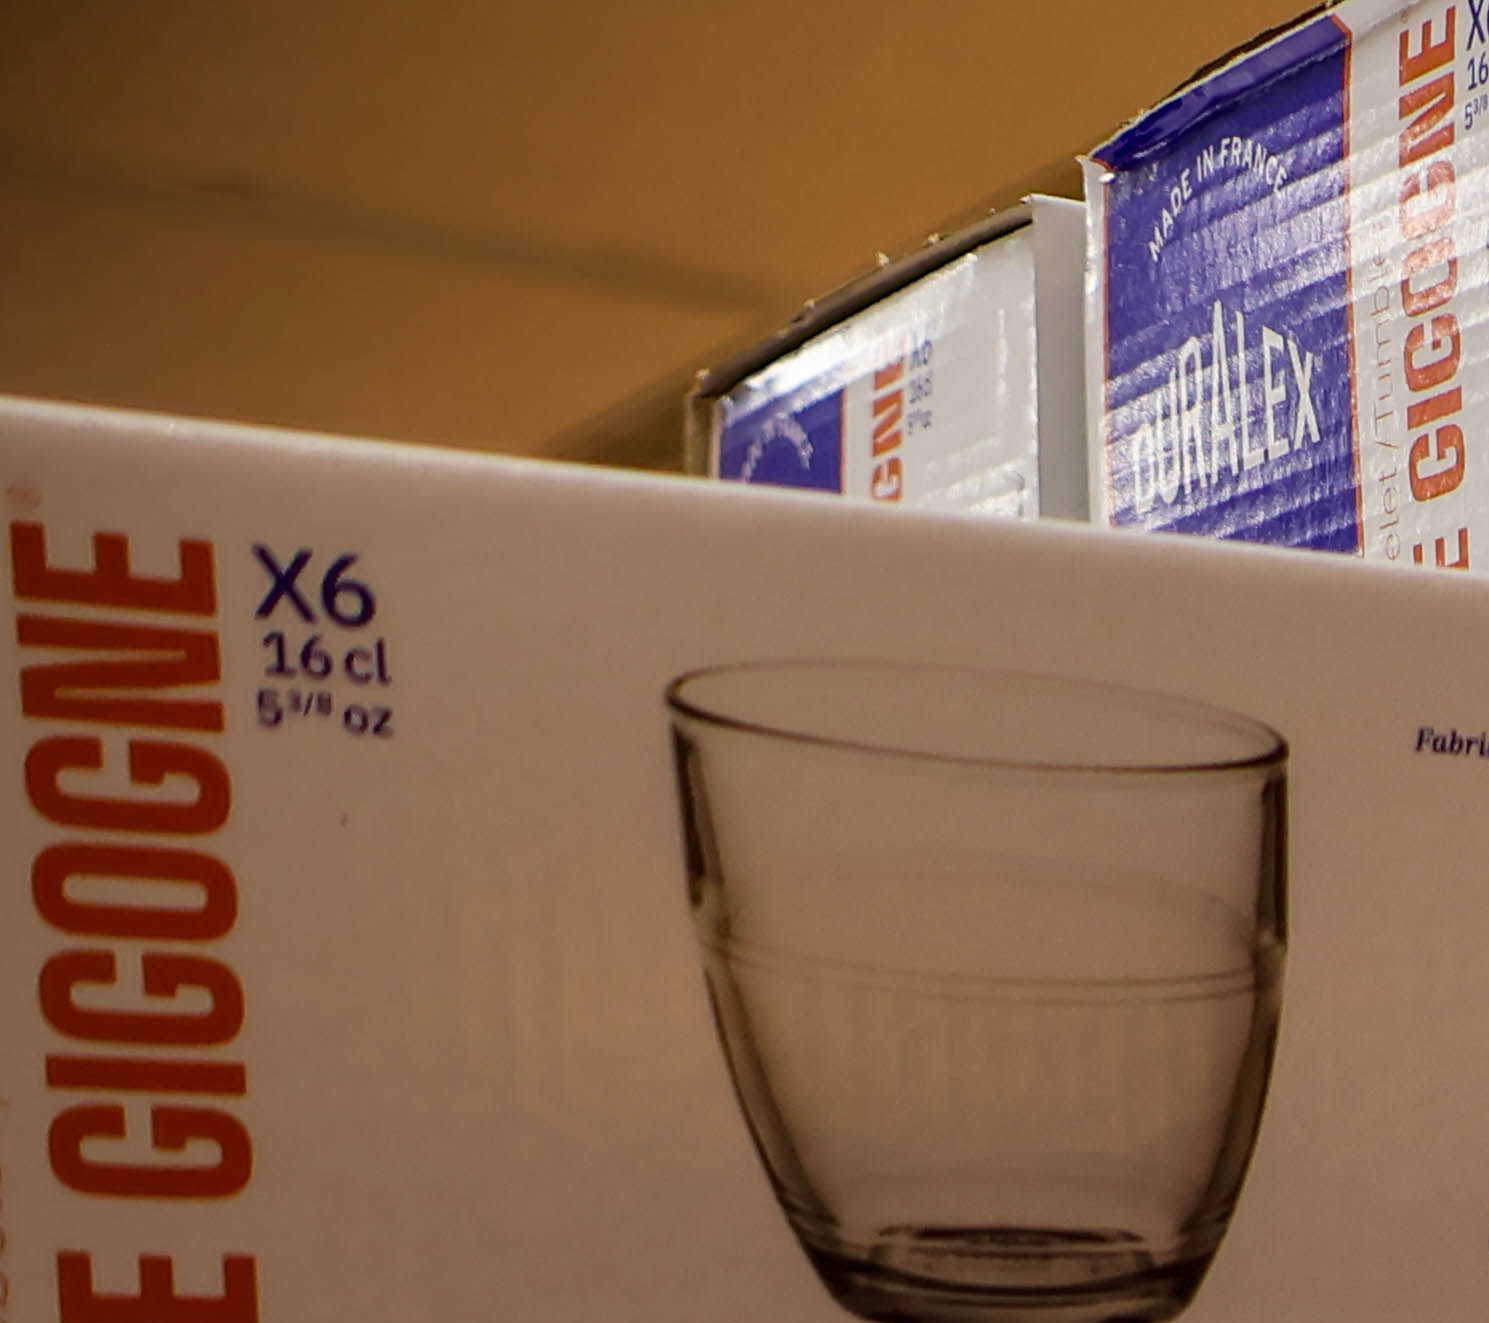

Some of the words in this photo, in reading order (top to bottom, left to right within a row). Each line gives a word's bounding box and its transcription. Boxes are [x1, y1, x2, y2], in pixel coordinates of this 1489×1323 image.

[1148, 168, 1193, 263] MADE
[1196, 151, 1215, 182] IN
[1218, 136, 1288, 197] FRANCE
[251, 545, 376, 629] X6
